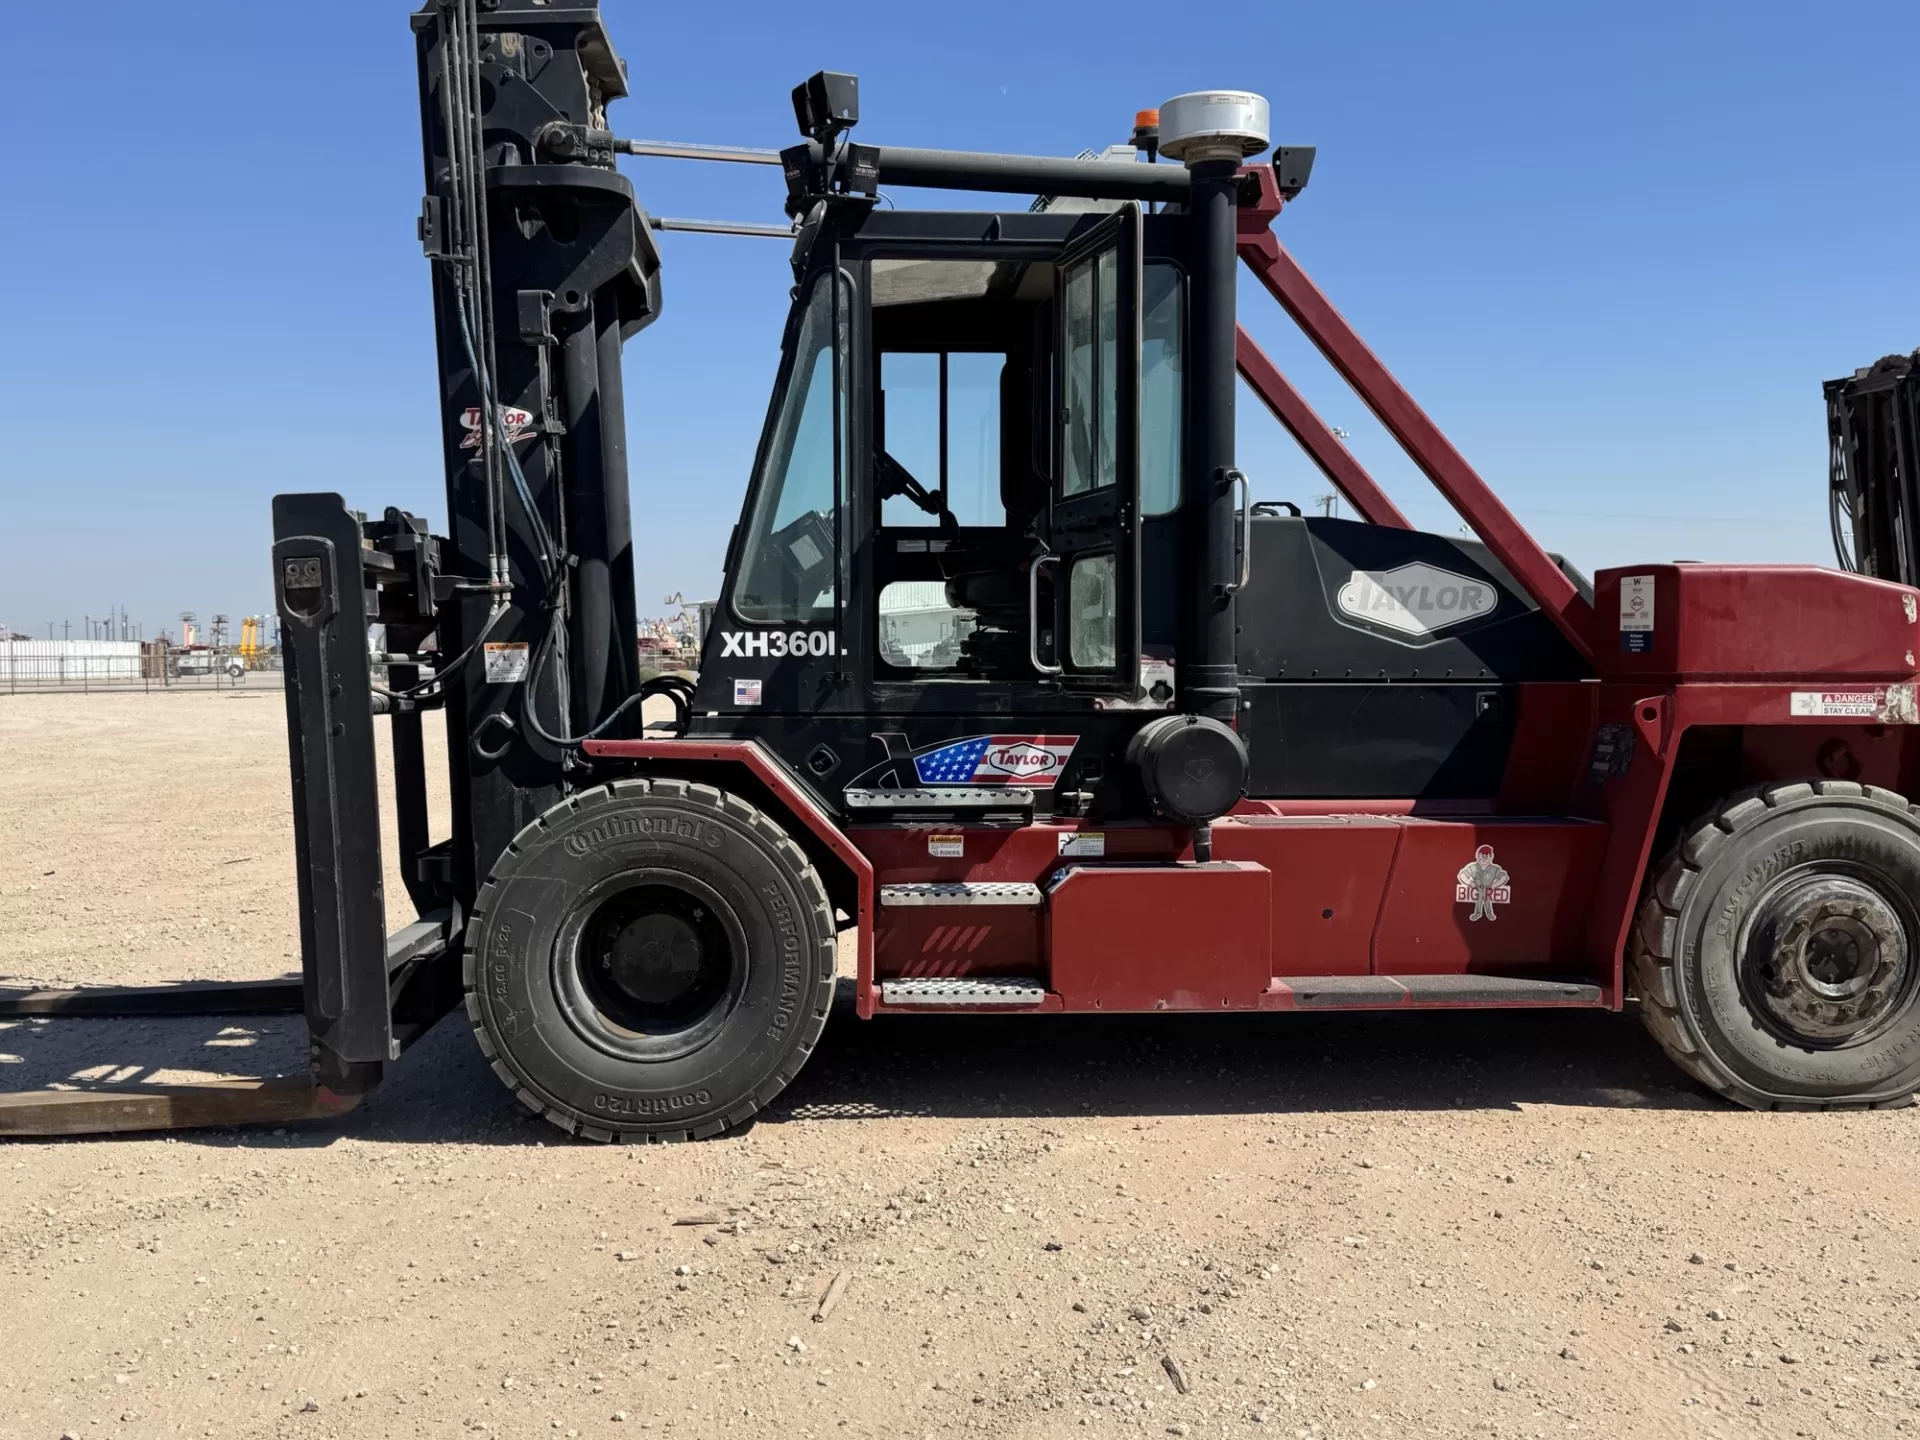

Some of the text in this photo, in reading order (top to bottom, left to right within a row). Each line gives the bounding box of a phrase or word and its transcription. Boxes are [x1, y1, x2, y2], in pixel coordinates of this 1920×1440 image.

[466, 408, 526, 426] TOR
[1353, 573, 1483, 611] TAYLOR
[1834, 694, 1875, 703] DANGER
[1844, 707, 1872, 715] CLEAR
[998, 750, 1049, 766] TAYLOR
[564, 815, 705, 857] Continental
[1458, 886, 1509, 902] BIG RED
[763, 880, 801, 1041] PERFORMANCE
